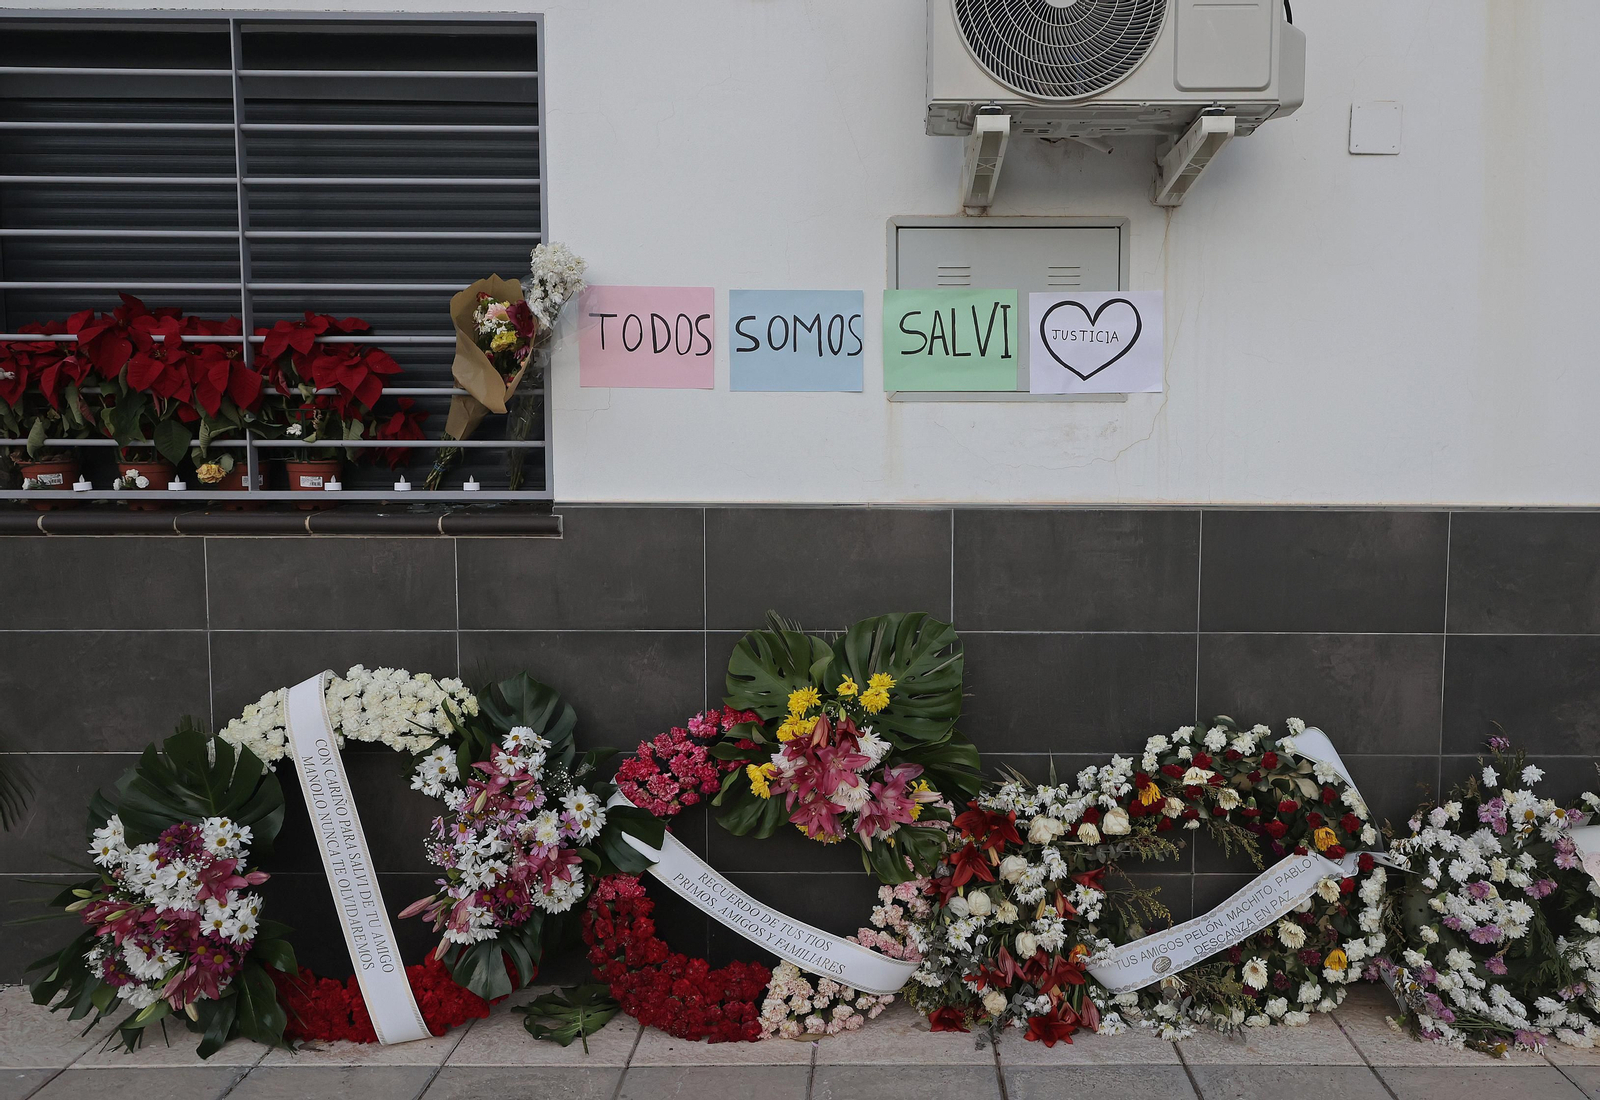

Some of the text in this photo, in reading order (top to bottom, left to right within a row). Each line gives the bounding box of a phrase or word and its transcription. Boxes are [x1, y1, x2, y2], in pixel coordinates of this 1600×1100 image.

[589, 312, 712, 357] TODOS
[735, 313, 864, 358] SOMOS
[900, 302, 1012, 360] SALVI
[1051, 329, 1119, 344] JUSTICIA
[301, 755, 375, 970] MANOLO NUNCA TE OLVIDAREMOS
[315, 739, 395, 973] CON CARIÑO PARA SALVI DE TU AMIGO
[698, 872, 833, 952] RECUERDO DE TUS TIOS
[718, 906, 766, 937] AMIGOS
[766, 932, 776, 941] Y
[774, 938, 846, 975] FAMILIARES
[1115, 955, 1138, 971] TUS
[1140, 938, 1184, 962] AMIGOS
[1184, 918, 1228, 943] PELÓN,
[1226, 884, 1277, 922] MACHITO,
[1275, 858, 1312, 887] PABLO
[1193, 890, 1297, 955] DESCANZA EN PAZ.
